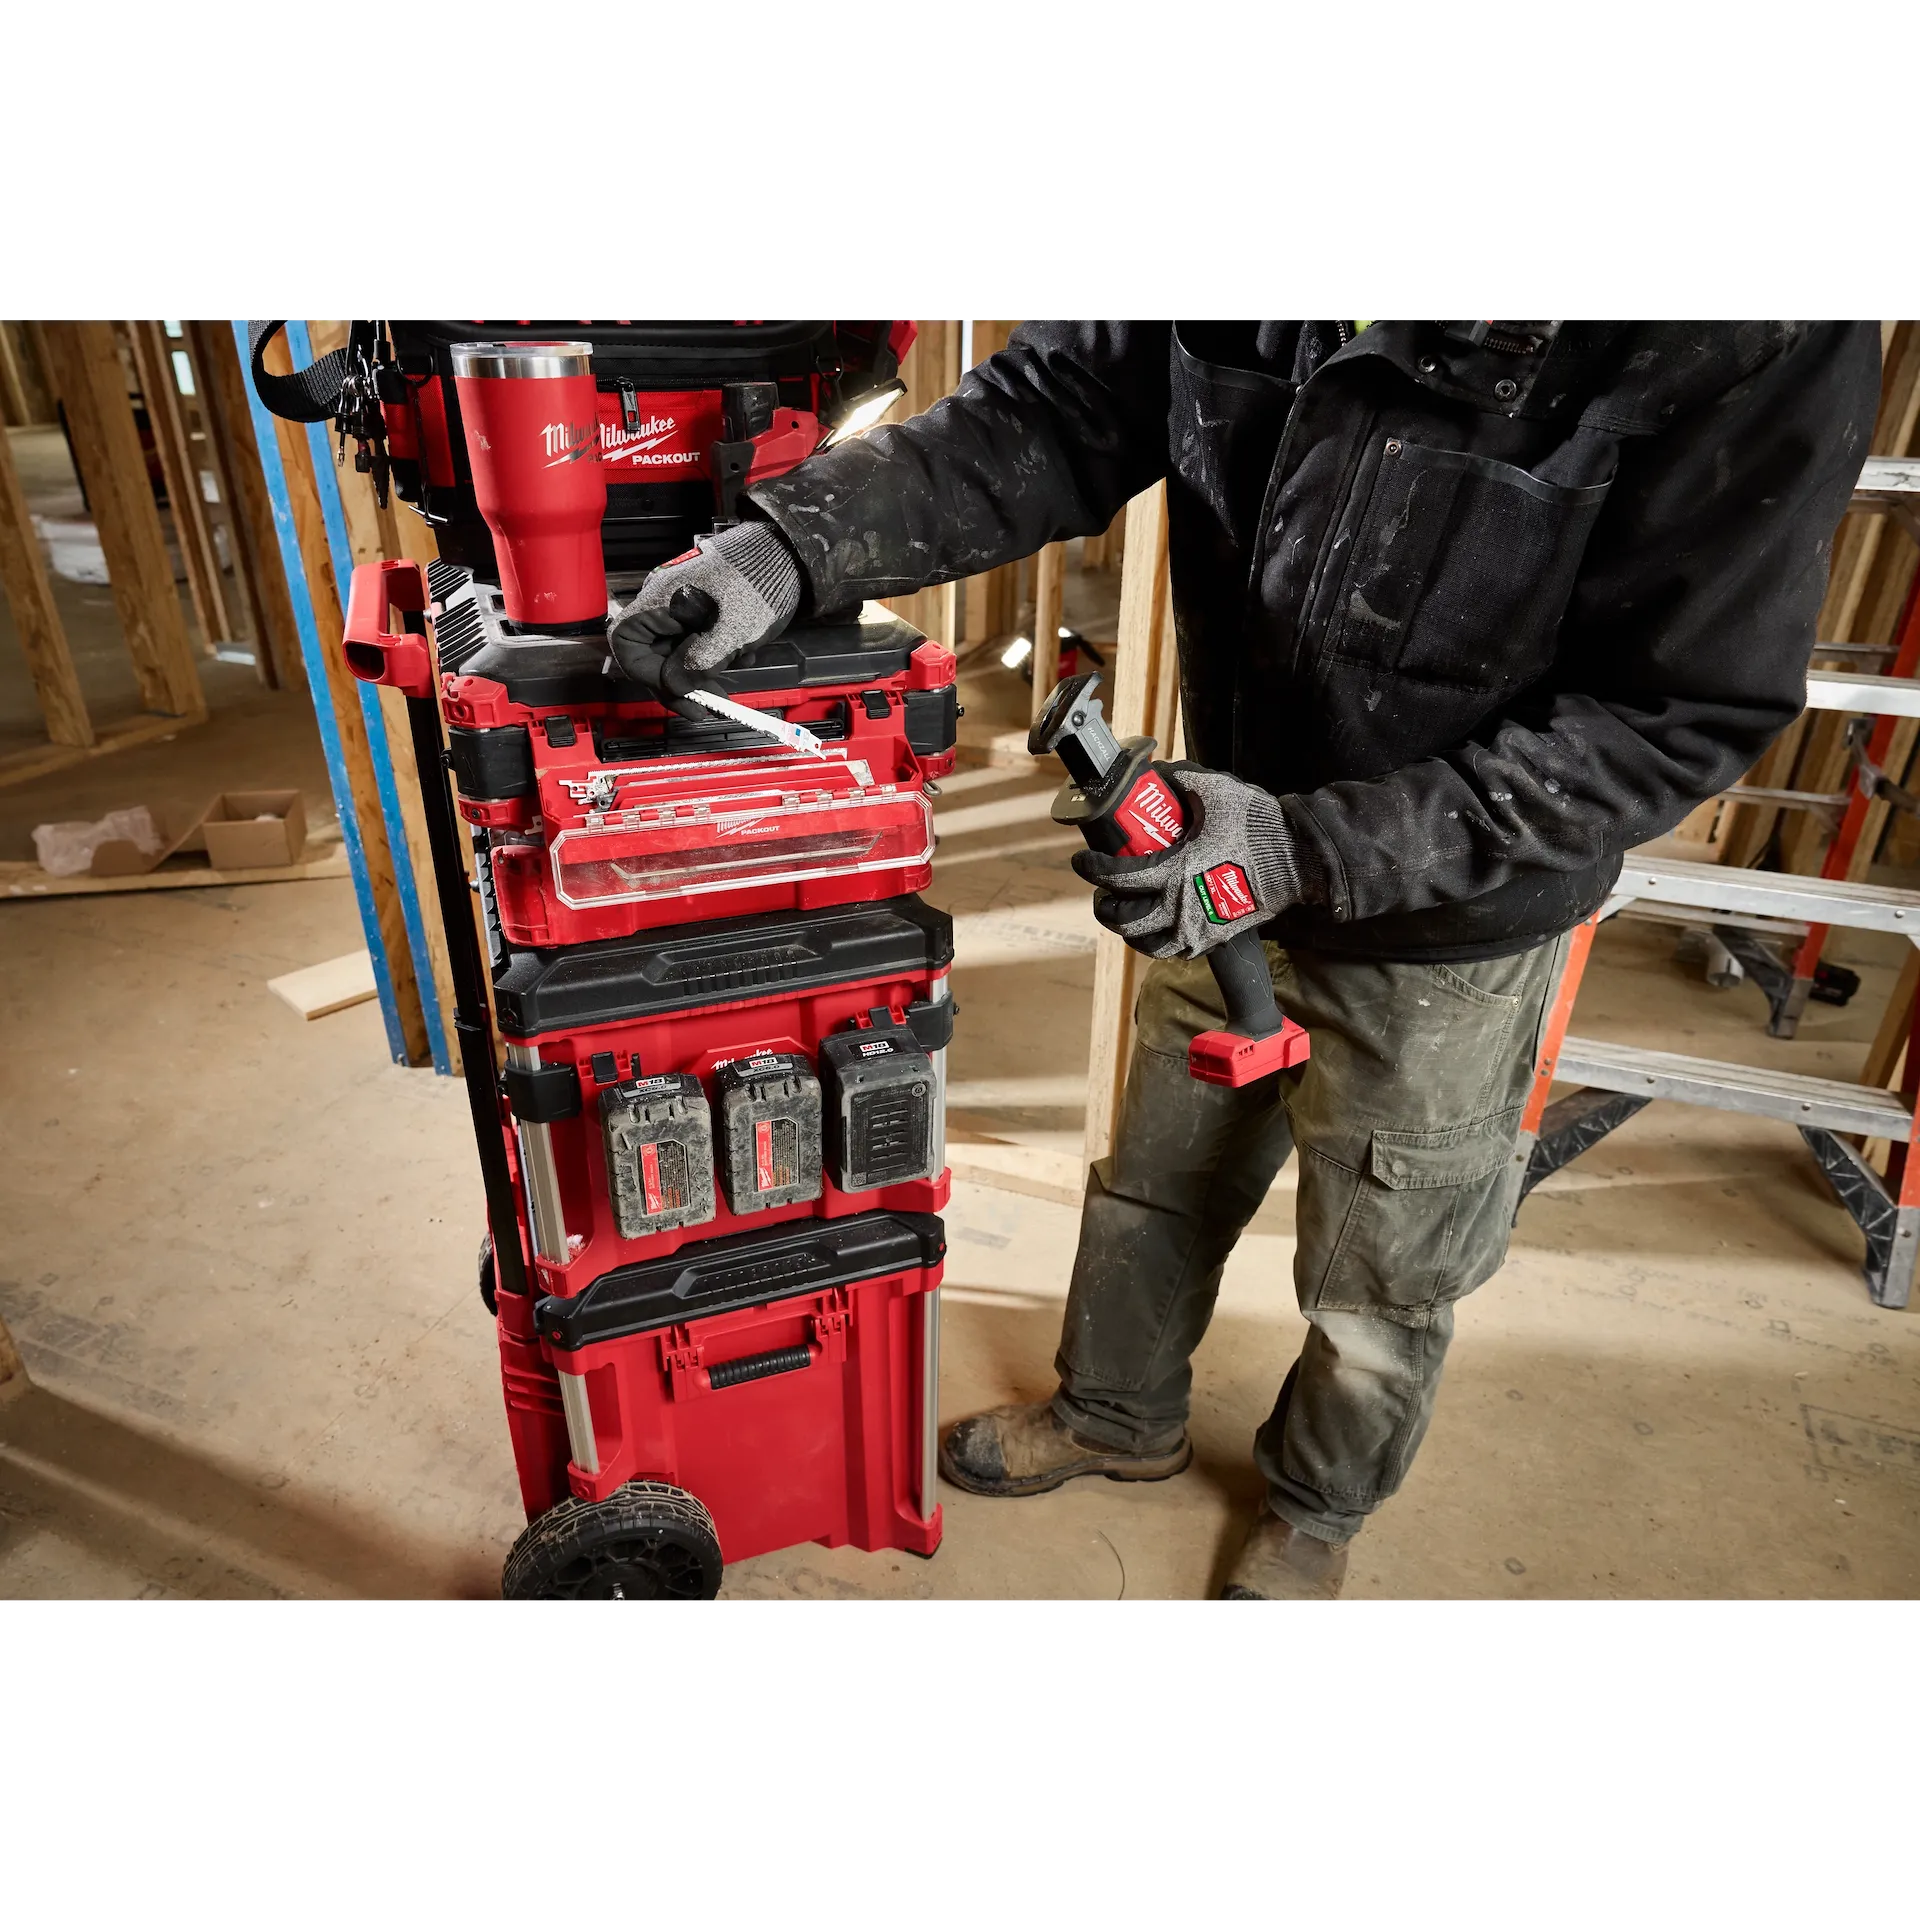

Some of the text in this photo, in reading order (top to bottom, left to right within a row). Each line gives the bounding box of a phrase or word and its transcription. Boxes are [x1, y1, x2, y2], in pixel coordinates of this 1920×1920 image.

[632, 451, 700, 465] PACKOUT
[1087, 726, 1112, 763] HACKZALL
[741, 825, 780, 836] PACKOUT
[1198, 885, 1207, 896] CUT
[1221, 867, 1251, 905] Milwaukee
[1202, 895, 1212, 912] LEVEL
[862, 1042, 887, 1052] M18
[750, 1058, 775, 1067] M18
[637, 1078, 663, 1087] M18
